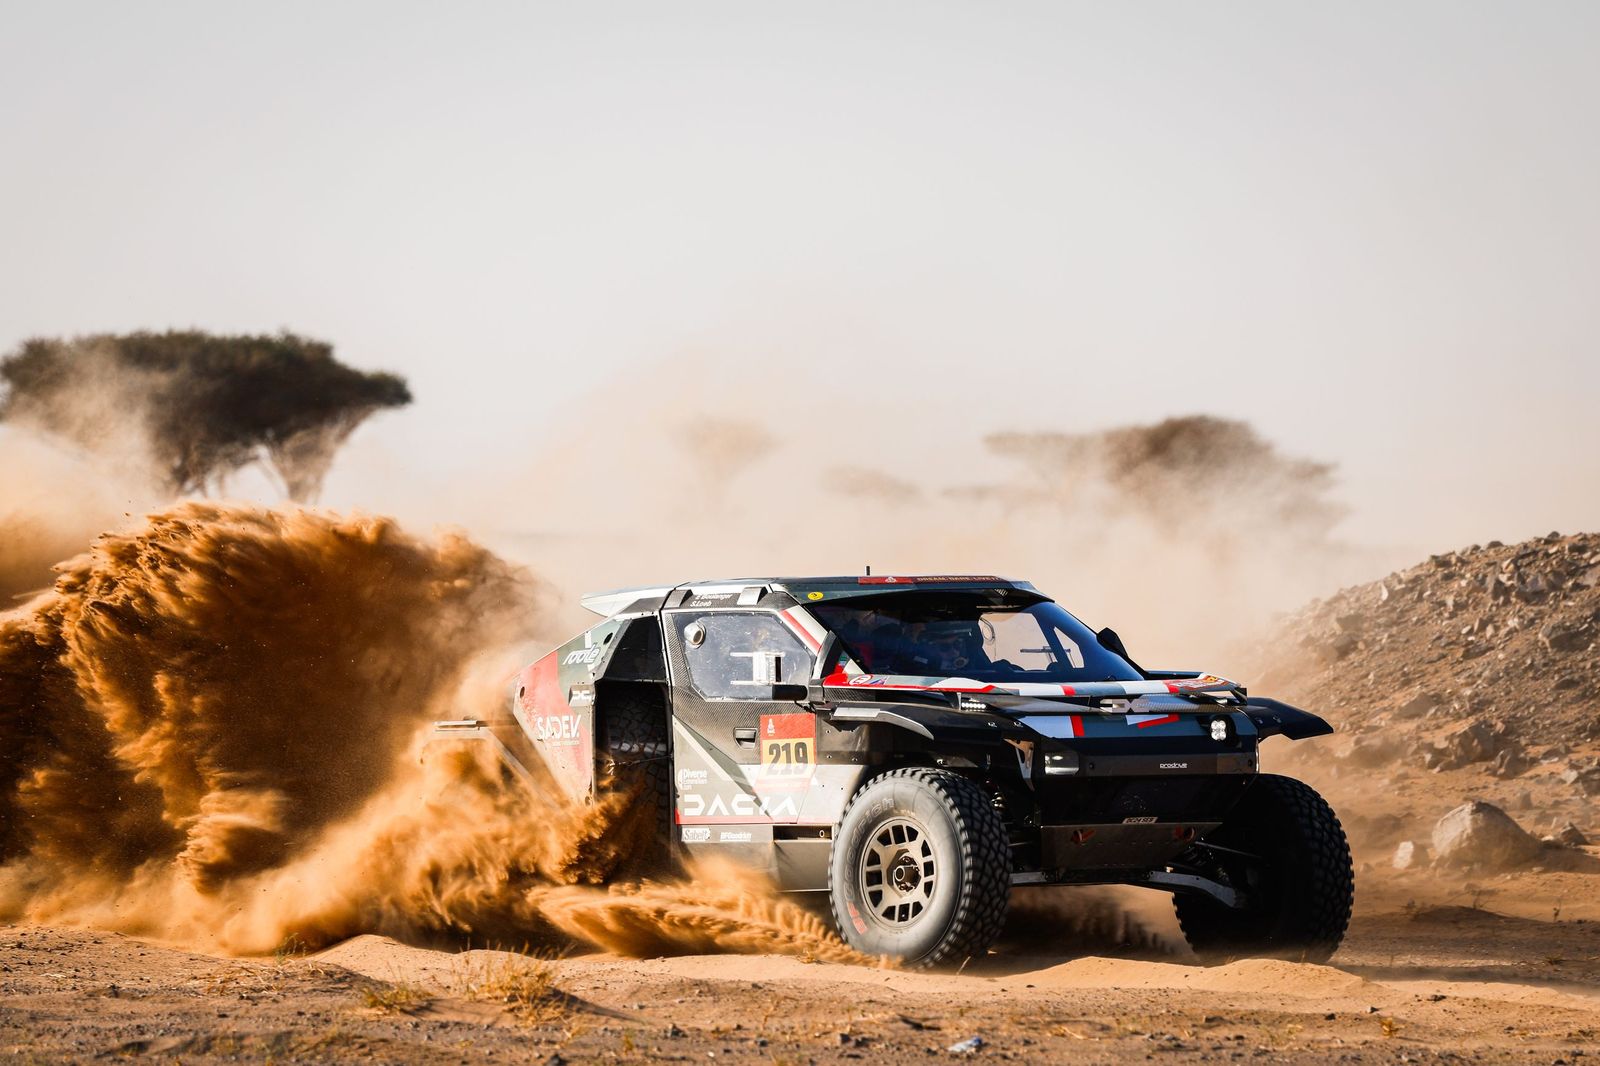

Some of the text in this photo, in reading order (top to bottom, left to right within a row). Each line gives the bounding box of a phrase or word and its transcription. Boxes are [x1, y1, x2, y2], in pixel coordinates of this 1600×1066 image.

[536, 715, 582, 739] SADEV
[766, 741, 809, 776] 219
[683, 793, 799, 816] DACIA
